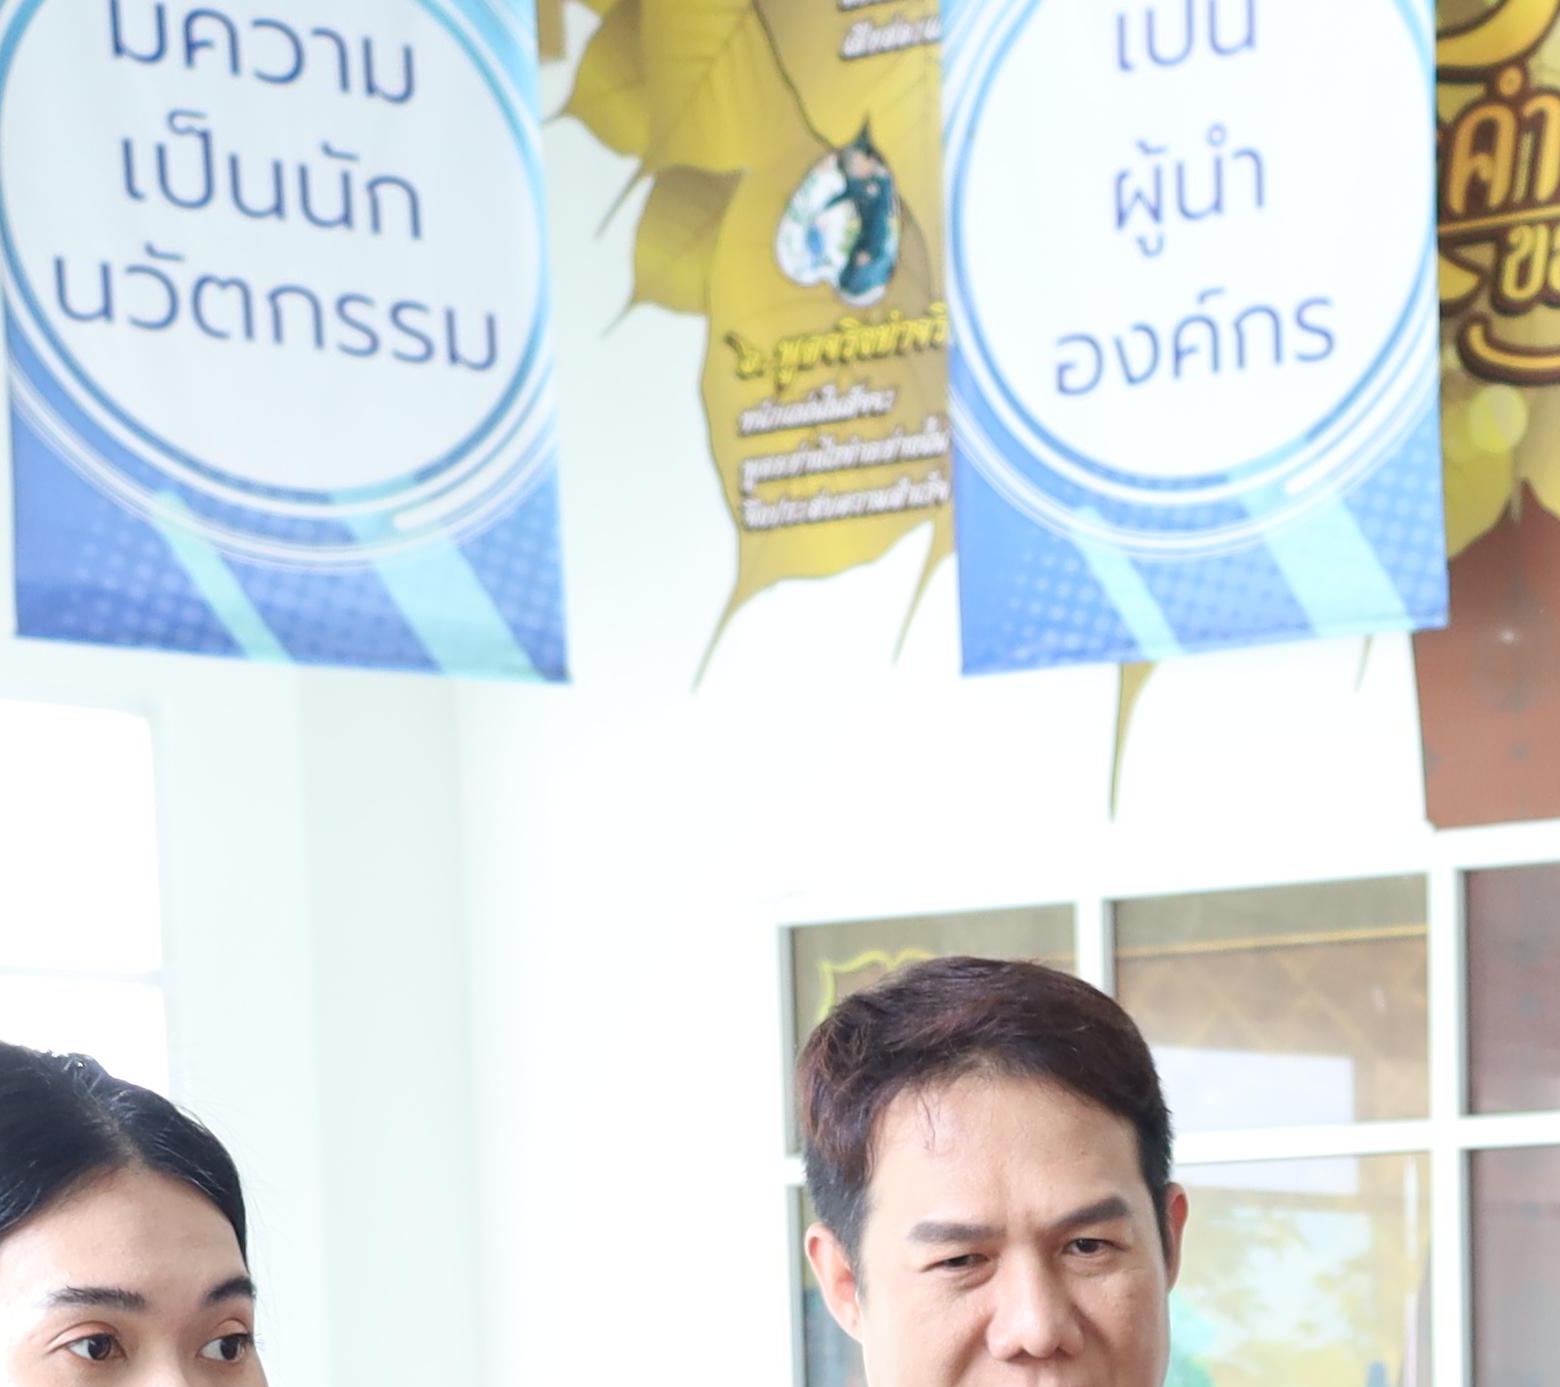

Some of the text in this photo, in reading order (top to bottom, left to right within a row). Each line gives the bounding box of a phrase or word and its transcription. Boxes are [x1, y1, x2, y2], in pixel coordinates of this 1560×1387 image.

[108, 0, 416, 104] มความ
[1116, 0, 1258, 72] เปน
[122, 107, 422, 241] เป็นนัก
[1114, 121, 1266, 258] ผู้นำ
[54, 242, 498, 372] นวัตกรรม
[1055, 286, 1336, 397] องค์กร
